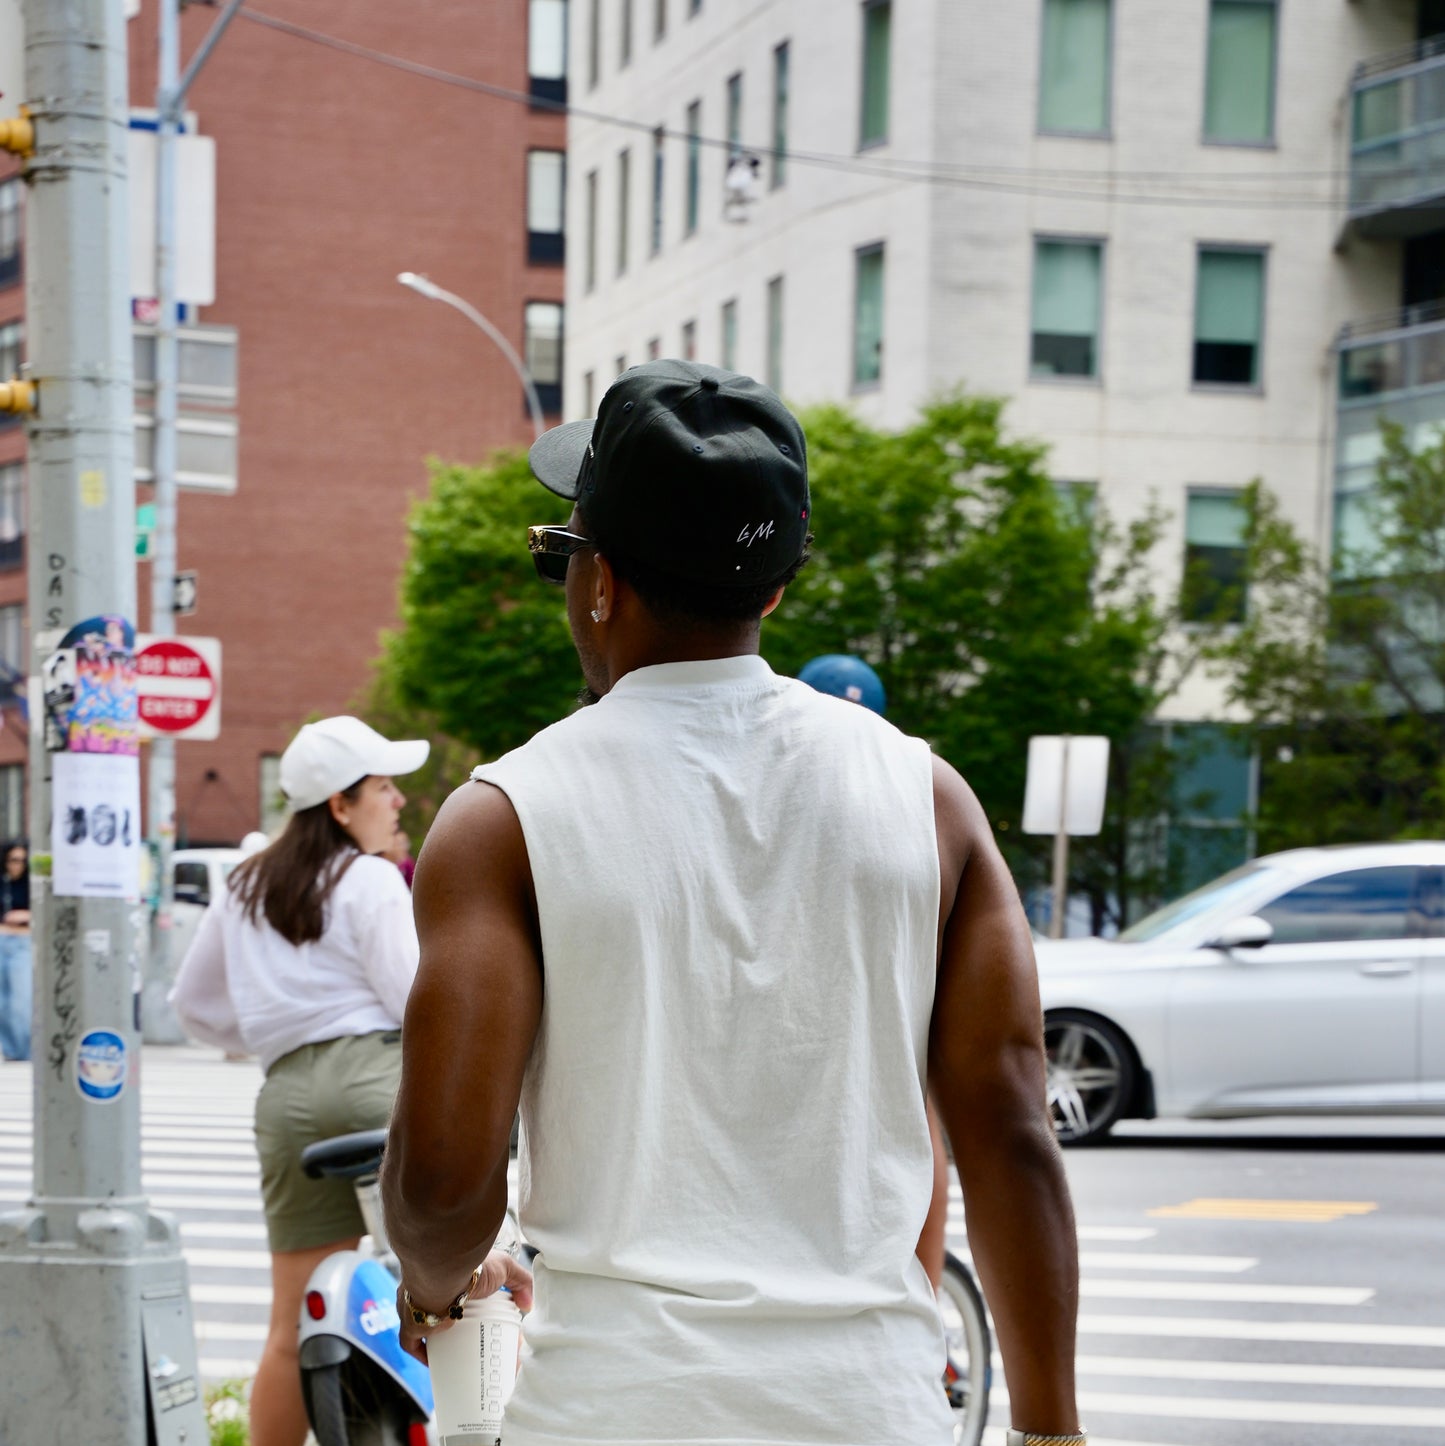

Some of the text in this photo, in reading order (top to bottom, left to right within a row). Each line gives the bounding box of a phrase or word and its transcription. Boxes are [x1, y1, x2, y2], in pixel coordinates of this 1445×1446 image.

[140, 656, 200, 675] DO NOT
[143, 699, 196, 718] ENTER
